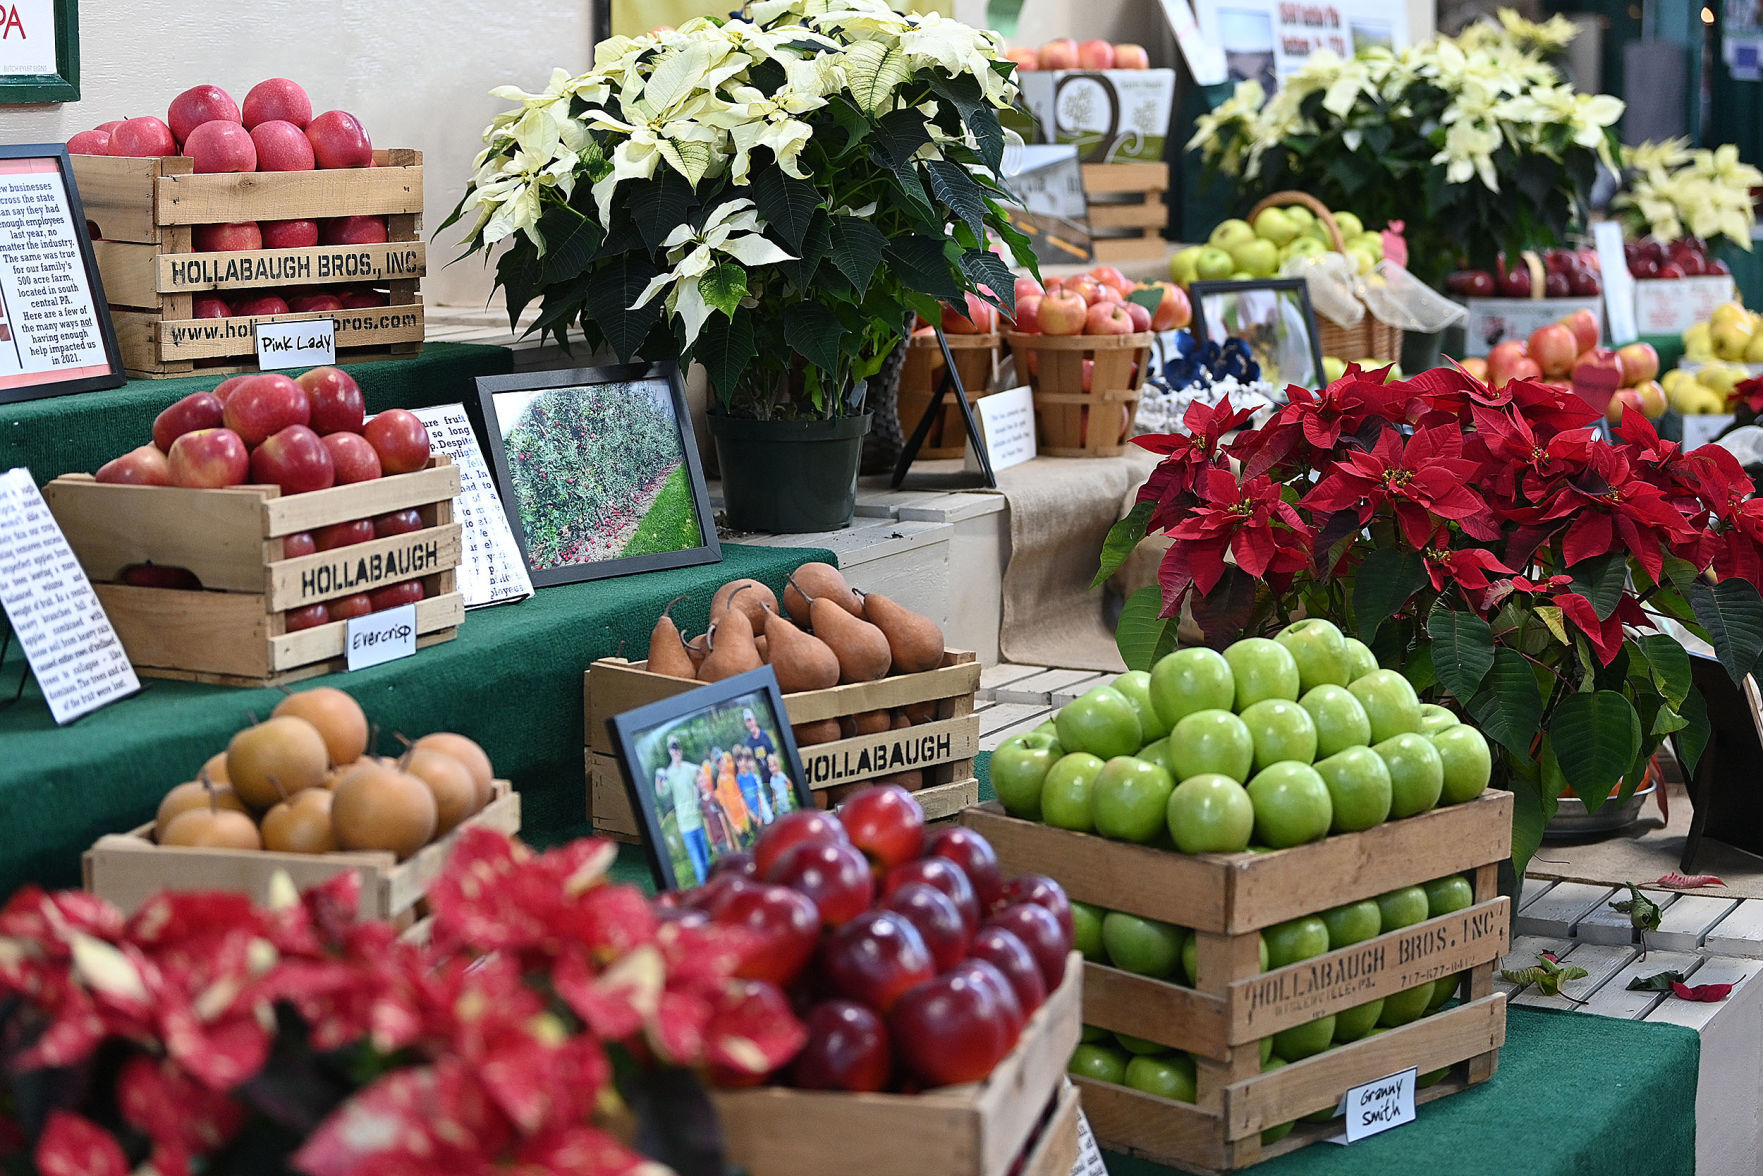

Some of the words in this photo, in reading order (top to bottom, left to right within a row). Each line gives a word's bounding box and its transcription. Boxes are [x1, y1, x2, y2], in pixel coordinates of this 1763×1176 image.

[8, 183, 52, 192] businesses
[22, 194, 34, 203] the
[36, 194, 55, 202] state
[12, 208, 25, 217] say
[26, 206, 44, 217] they
[45, 204, 60, 213] had
[26, 217, 65, 228] employees
[10, 230, 25, 239] last
[26, 230, 47, 240] year,
[47, 229, 57, 237] no
[0, 241, 25, 252] matter
[26, 240, 39, 250] the
[40, 238, 75, 249] industry.
[3, 254, 19, 263] The
[20, 253, 41, 262] same
[43, 252, 58, 260] was
[13, 265, 25, 274] for
[26, 265, 39, 274] our
[40, 261, 73, 272] family's
[172, 255, 311, 285] HOLLABAUGH
[386, 250, 417, 274] INC
[17, 275, 31, 285] 500
[33, 276, 50, 284] acre
[51, 274, 74, 283] farm,
[17, 286, 47, 298] located
[48, 286, 57, 294] in
[58, 283, 79, 293] south
[30, 297, 58, 308] central
[60, 296, 73, 305] PA.
[23, 311, 43, 321] Here
[44, 311, 57, 319] are
[64, 307, 78, 316] few
[80, 305, 88, 314] of
[21, 324, 35, 333] the
[36, 322, 58, 332] many
[59, 320, 79, 330] ways
[80, 317, 93, 327] not
[31, 333, 59, 344] having
[60, 329, 89, 341] enough
[29, 346, 48, 356] help
[49, 341, 86, 354] impacted
[87, 341, 96, 349] us
[262, 335, 293, 352] Pink
[297, 334, 332, 353] Lady
[51, 356, 60, 365] in
[61, 353, 82, 364] 2021.
[444, 414, 466, 424] fruit
[432, 430, 443, 438] so
[448, 427, 470, 435] long
[476, 470, 488, 478] In
[302, 541, 438, 598] HOLLABAUGH
[53, 617, 84, 635] combined
[90, 610, 103, 621] with
[77, 678, 90, 688] The
[90, 672, 107, 683] trees
[107, 666, 120, 676] and
[120, 661, 129, 671] all
[96, 685, 112, 696] were
[1251, 945, 1385, 1010] HOLLABAUGH
[1399, 926, 1456, 965] BROS.
[1361, 1079, 1404, 1106] Granny
[1362, 1098, 1401, 1126] Smith
